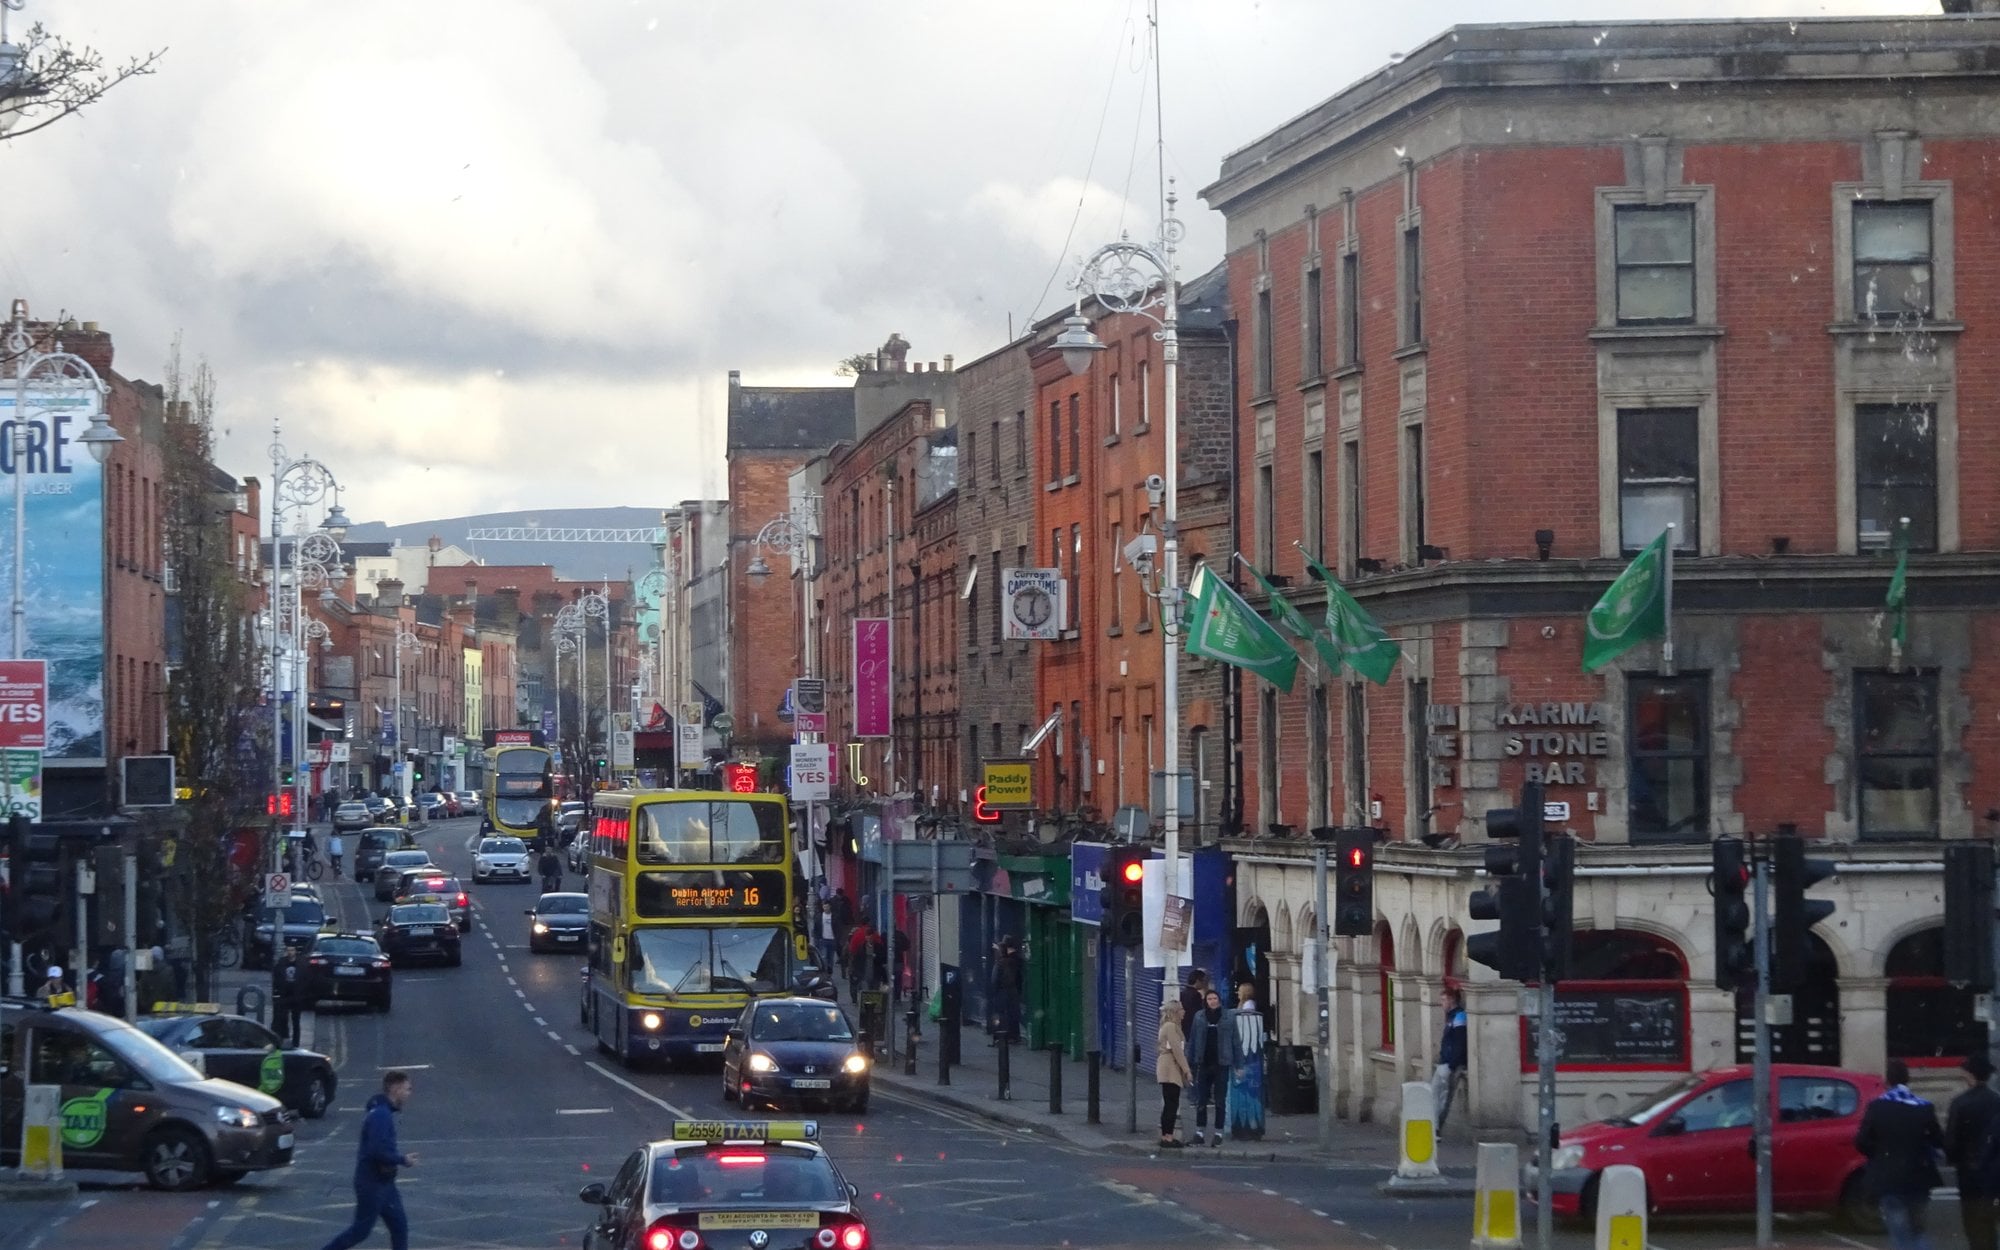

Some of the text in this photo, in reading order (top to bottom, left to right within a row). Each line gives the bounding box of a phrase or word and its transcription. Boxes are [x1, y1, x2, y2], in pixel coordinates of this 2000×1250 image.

[32, 482, 72, 496] LAGER
[1008, 580, 1057, 595] CARPET TIME
[0, 704, 42, 722] YES
[1498, 703, 1606, 725] KARMA
[1505, 732, 1608, 755] STONE
[797, 772, 825, 783] YES
[988, 775, 1026, 784] Paddy
[1526, 762, 1585, 784] BAR
[988, 785, 1027, 794] Power
[672, 888, 735, 897] Dublin Airport
[743, 888, 759, 905] 16
[63, 1114, 99, 1130] TAXI
[689, 1123, 722, 1138] 25592
[726, 1122, 766, 1139] TAXI
[805, 1124, 815, 1138] D
